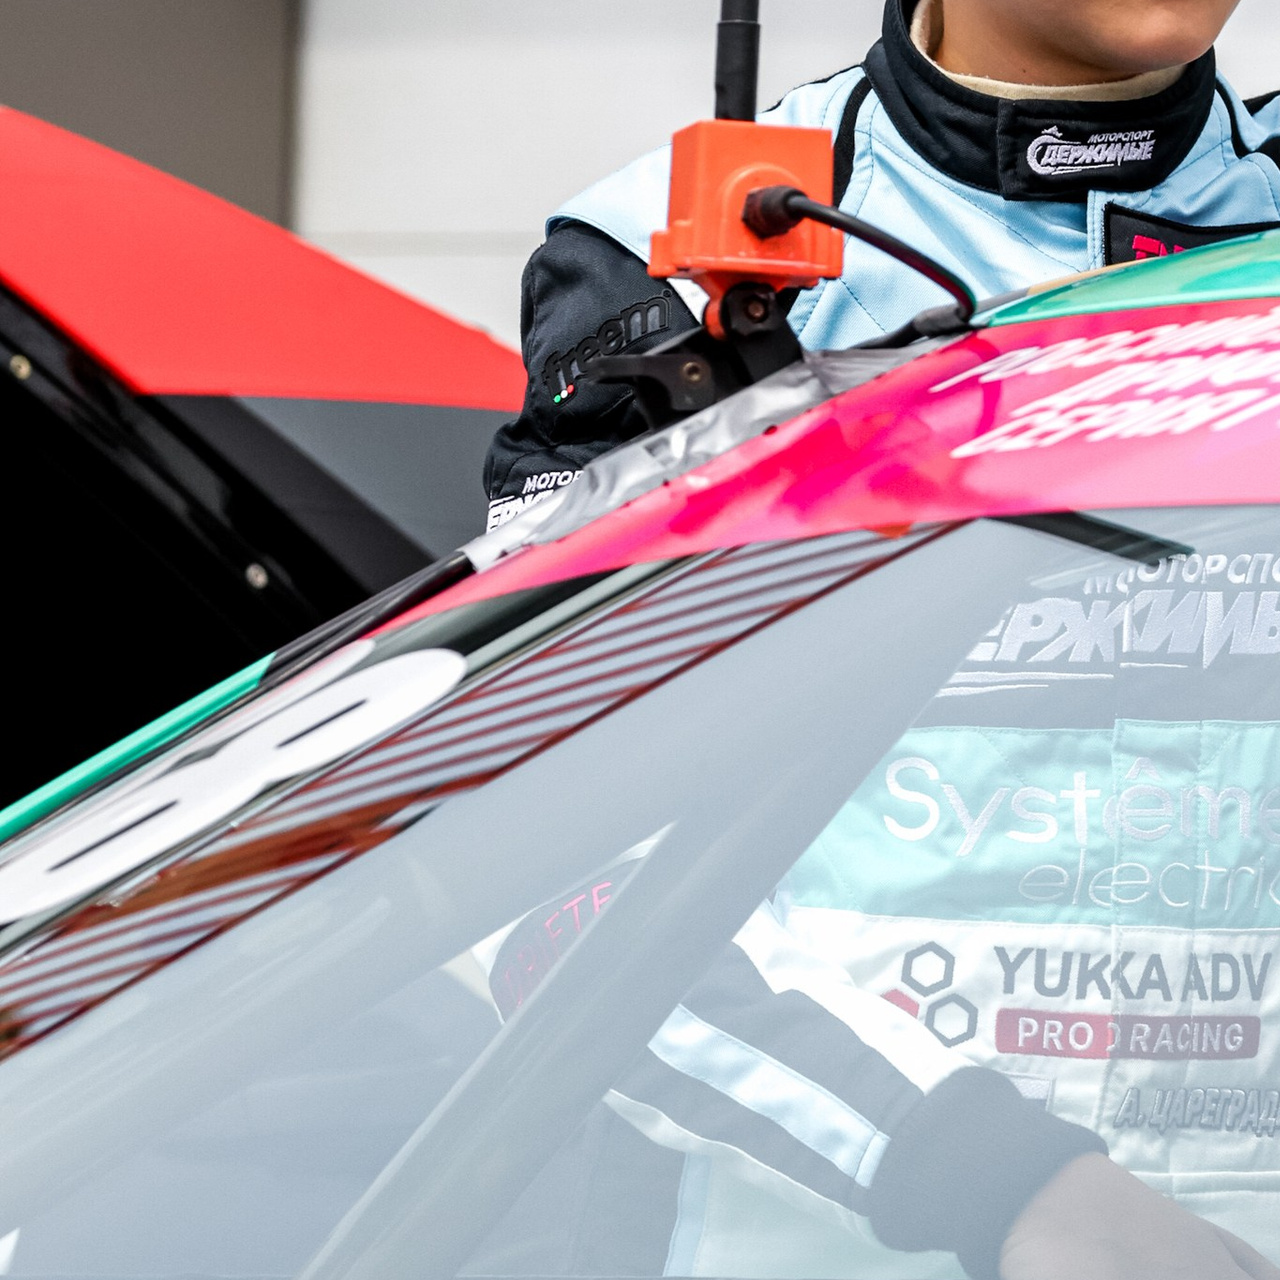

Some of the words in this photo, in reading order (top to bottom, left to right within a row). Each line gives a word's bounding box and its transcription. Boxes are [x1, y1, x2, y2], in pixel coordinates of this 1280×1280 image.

[541, 295, 670, 402] freem
[994, 945, 1173, 1002] YUKKA
[1181, 951, 1273, 1002] ADV
[1017, 1016, 1095, 1052] PRO
[1129, 1021, 1245, 1054] RACING
